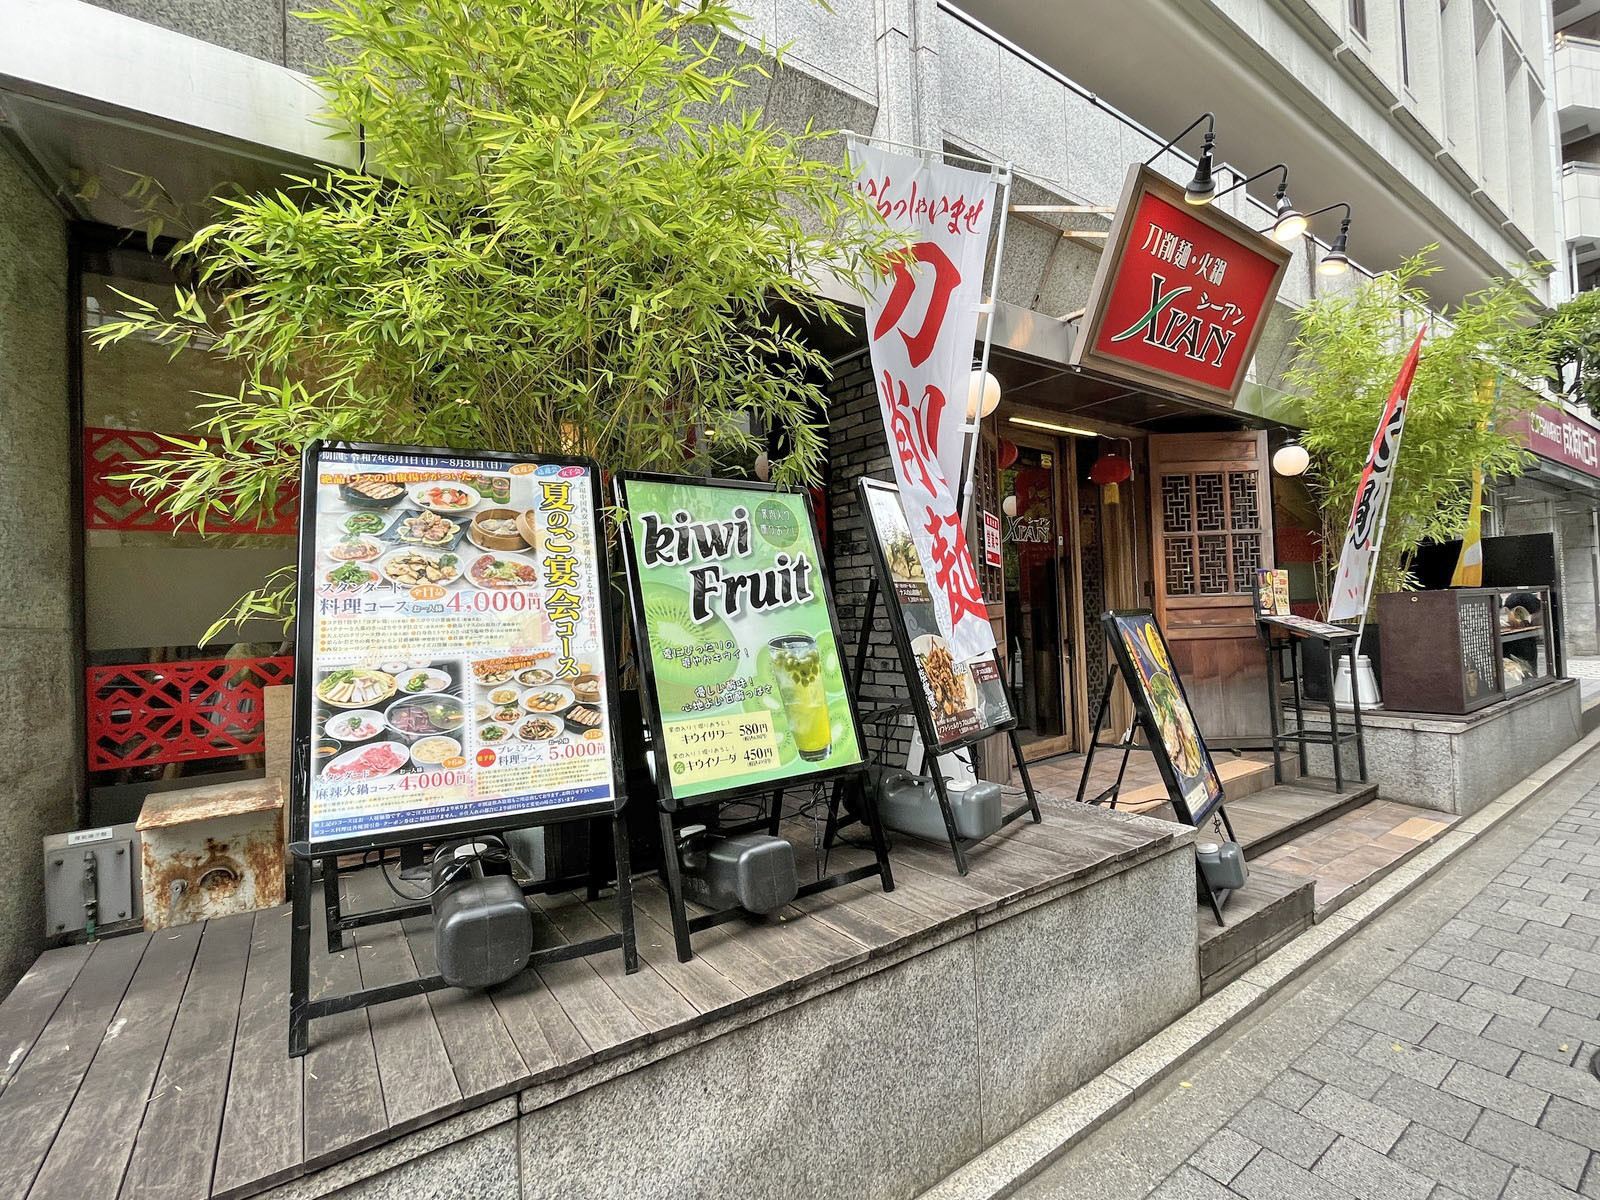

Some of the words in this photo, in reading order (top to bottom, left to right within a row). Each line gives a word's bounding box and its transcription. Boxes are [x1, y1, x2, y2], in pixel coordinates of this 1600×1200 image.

[857, 176, 985, 236] いらっしゃいませ
[1141, 222, 1229, 287] 刀削麺・火鍋
[1196, 291, 1246, 326] シーアン
[639, 506, 750, 566] kiwi
[321, 581, 402, 595] スタンダード
[538, 480, 582, 680] 夏のご宴会コース
[690, 553, 812, 621] Fruit
[320, 597, 410, 616] 料理コース
[446, 591, 541, 613] 4,000円
[662, 640, 735, 660] 夏にぴったりの
[681, 684, 773, 712] 心地よい甘酸っぱさ
[694, 676, 754, 698] 優しい酸味!
[738, 723, 768, 737] 580円
[499, 754, 544, 767] 料理コース
[686, 754, 737, 771] キウイソーダ
[743, 748, 773, 761] 450円
[315, 782, 397, 801] 麻辣火鍋コース
[399, 771, 467, 791] 4,000円
